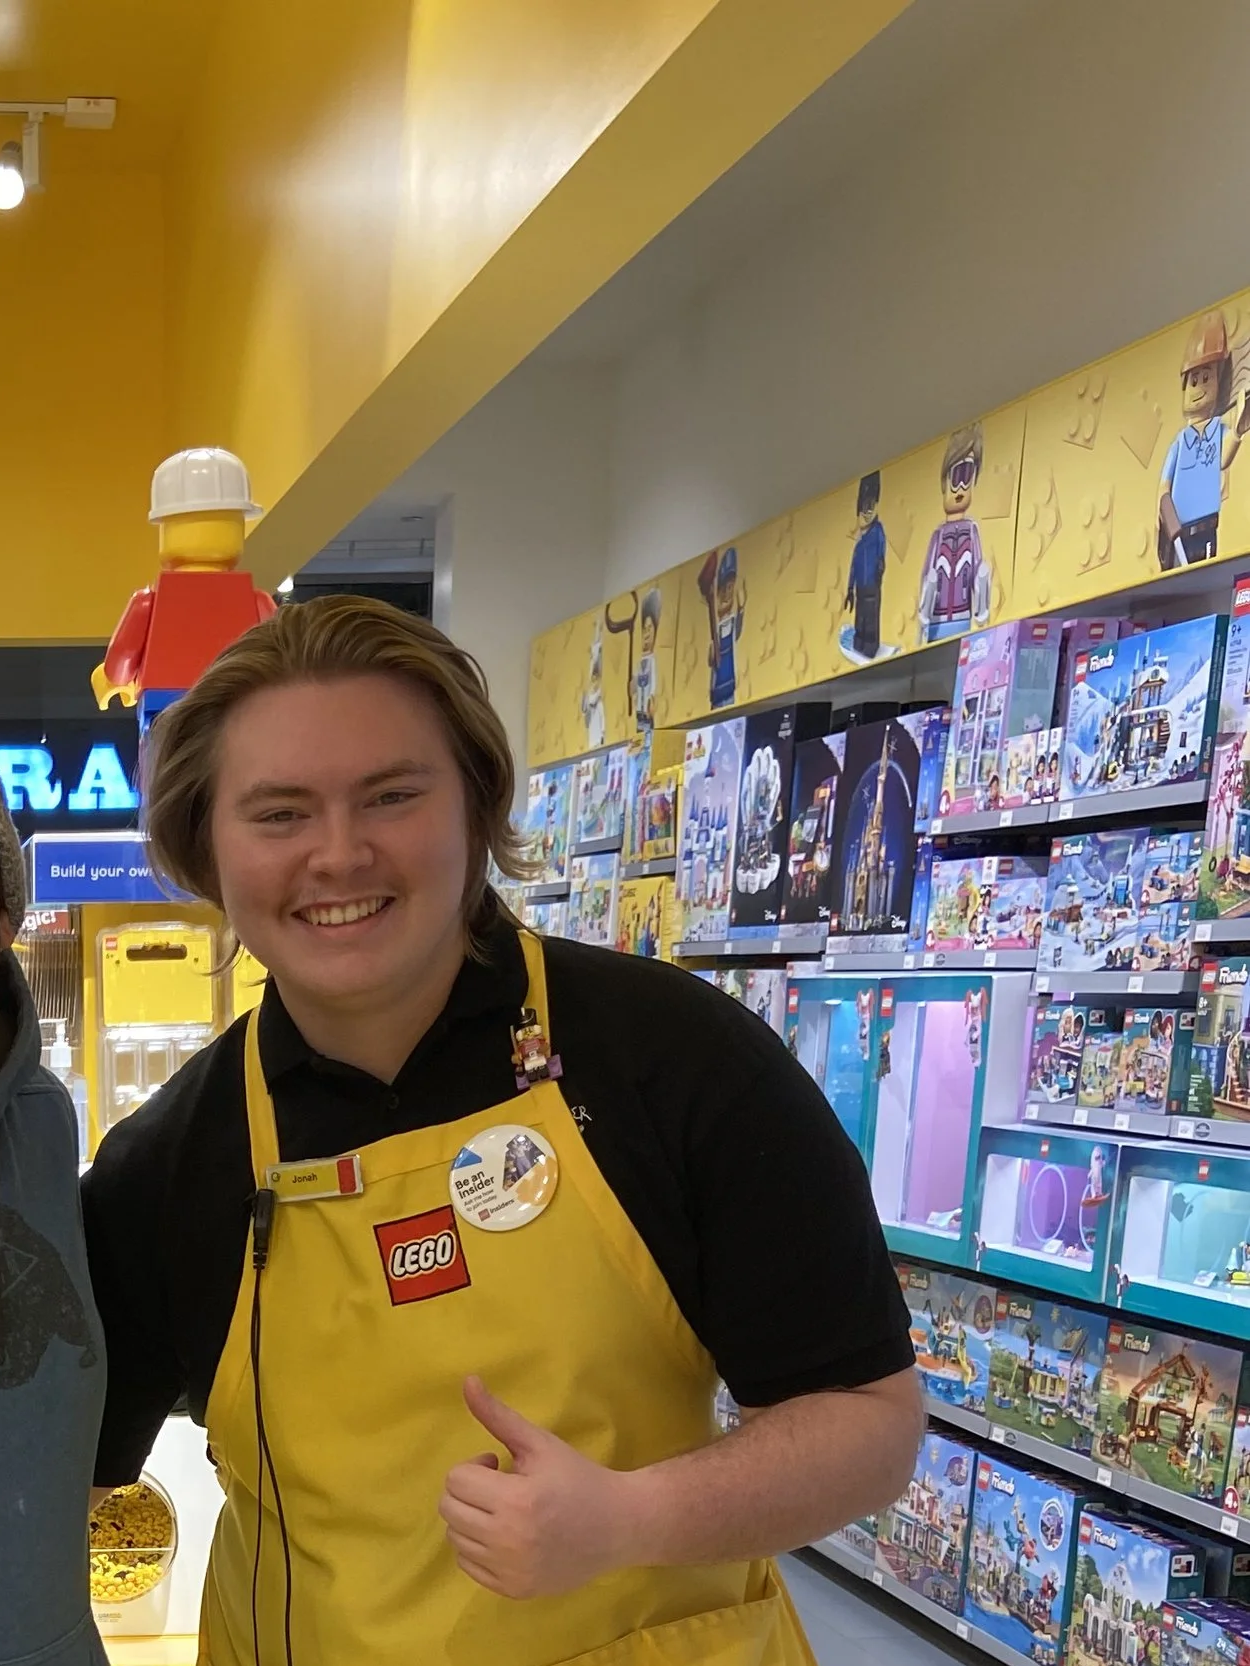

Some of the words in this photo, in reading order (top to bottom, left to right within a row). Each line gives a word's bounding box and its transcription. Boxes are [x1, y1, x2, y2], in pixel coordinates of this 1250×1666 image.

[50, 864, 86, 878] Build
[90, 867, 124, 881] your
[292, 1173, 318, 1184] Jonah
[455, 1178, 470, 1190] Be
[471, 1171, 485, 1183] an
[458, 1176, 495, 1199] Insider
[490, 1199, 515, 1214] Insiders
[391, 1232, 454, 1278] LEGO
[1009, 1301, 1032, 1321] Friends
[1124, 1333, 1151, 1354] Friends
[991, 1471, 1016, 1496] Friends
[1093, 1526, 1117, 1550] Friends
[1175, 1615, 1199, 1637] Friends
